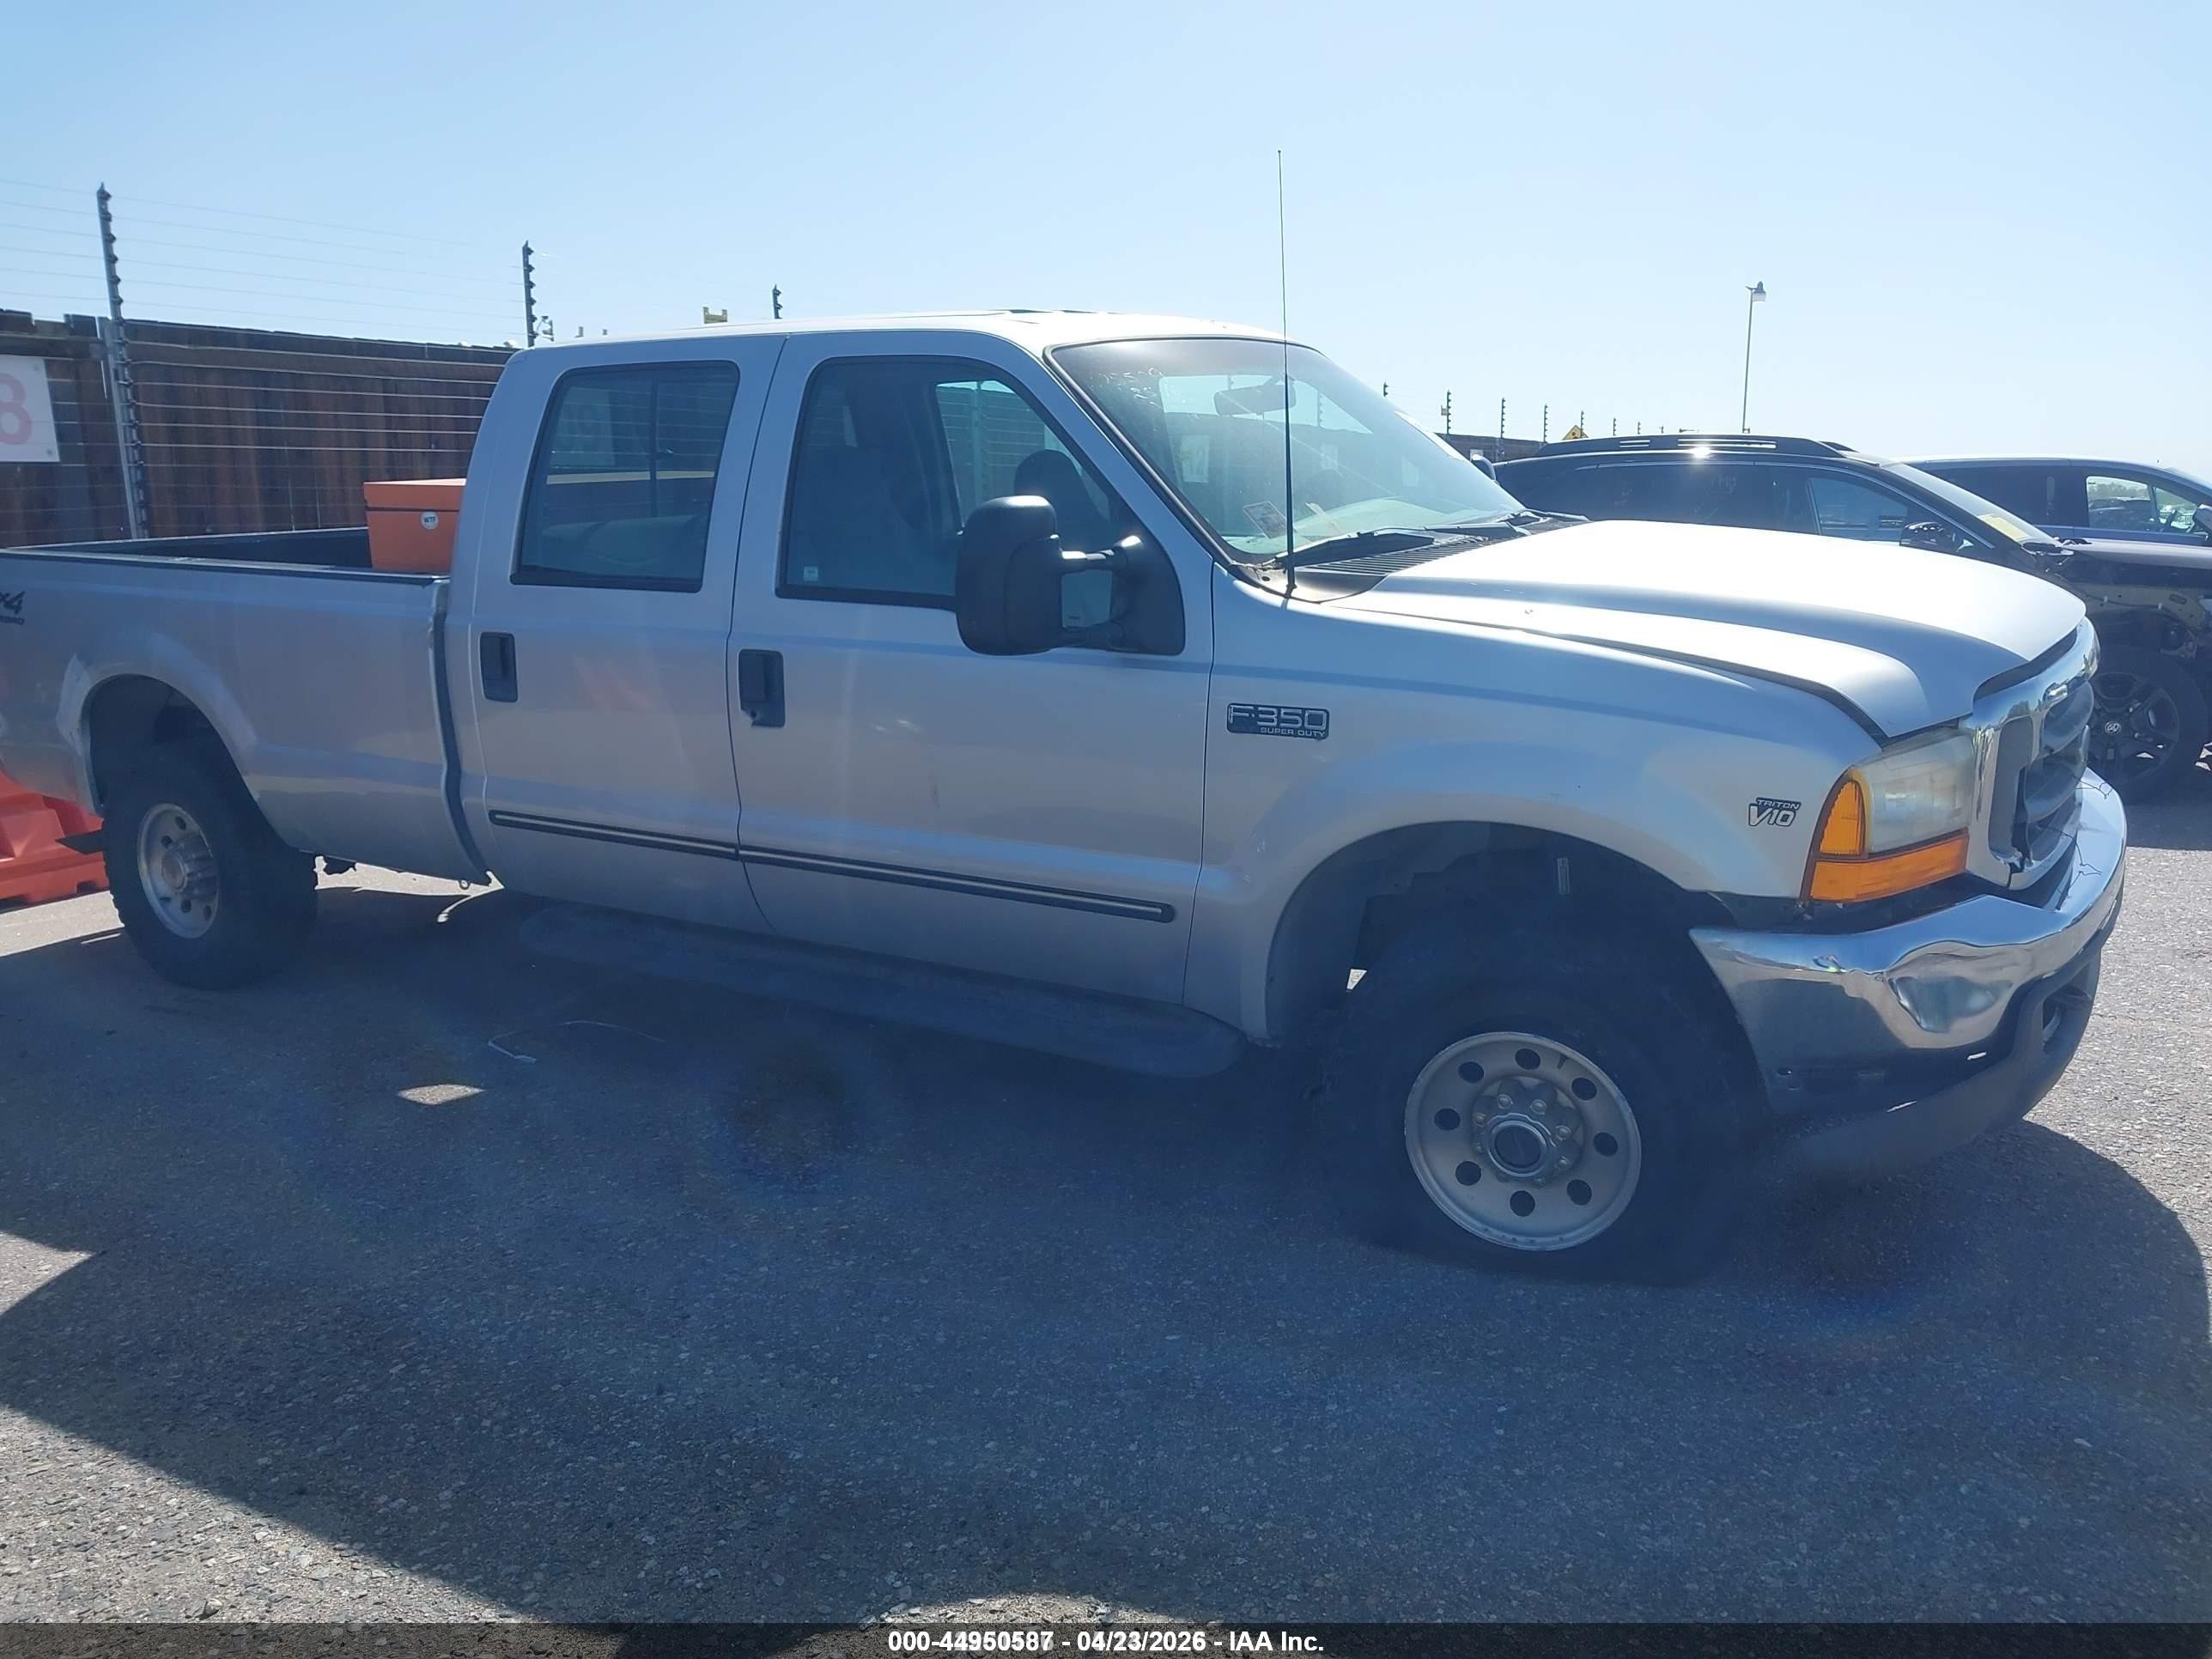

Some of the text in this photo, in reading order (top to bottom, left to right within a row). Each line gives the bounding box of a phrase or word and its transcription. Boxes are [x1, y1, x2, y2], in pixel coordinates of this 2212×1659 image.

[1260, 726, 1294, 735] SUPER
[1757, 799, 1801, 810] TRITON
[1750, 805, 1796, 827] V10
